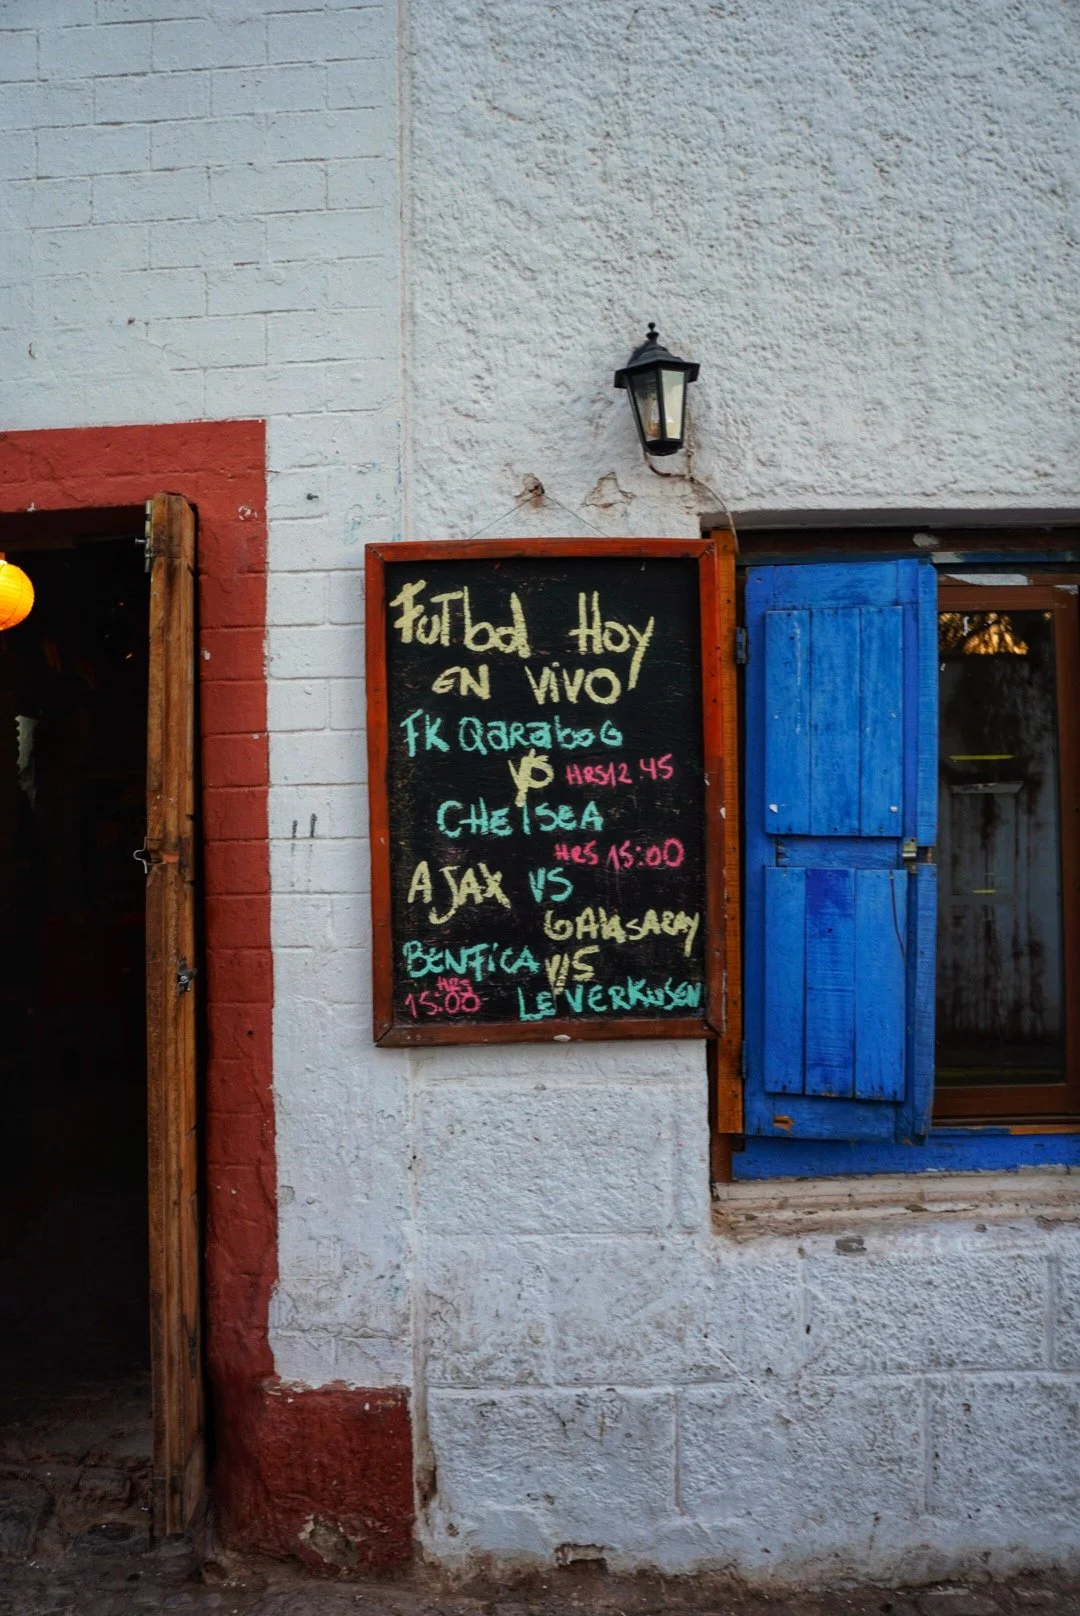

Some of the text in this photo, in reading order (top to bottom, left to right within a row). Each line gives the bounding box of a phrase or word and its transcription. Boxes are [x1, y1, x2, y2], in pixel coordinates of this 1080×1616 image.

[400, 708, 449, 757] FK
[607, 838, 684, 873] 15:00
[407, 860, 575, 925] AJAX VS
[404, 991, 482, 1018] 15:00
